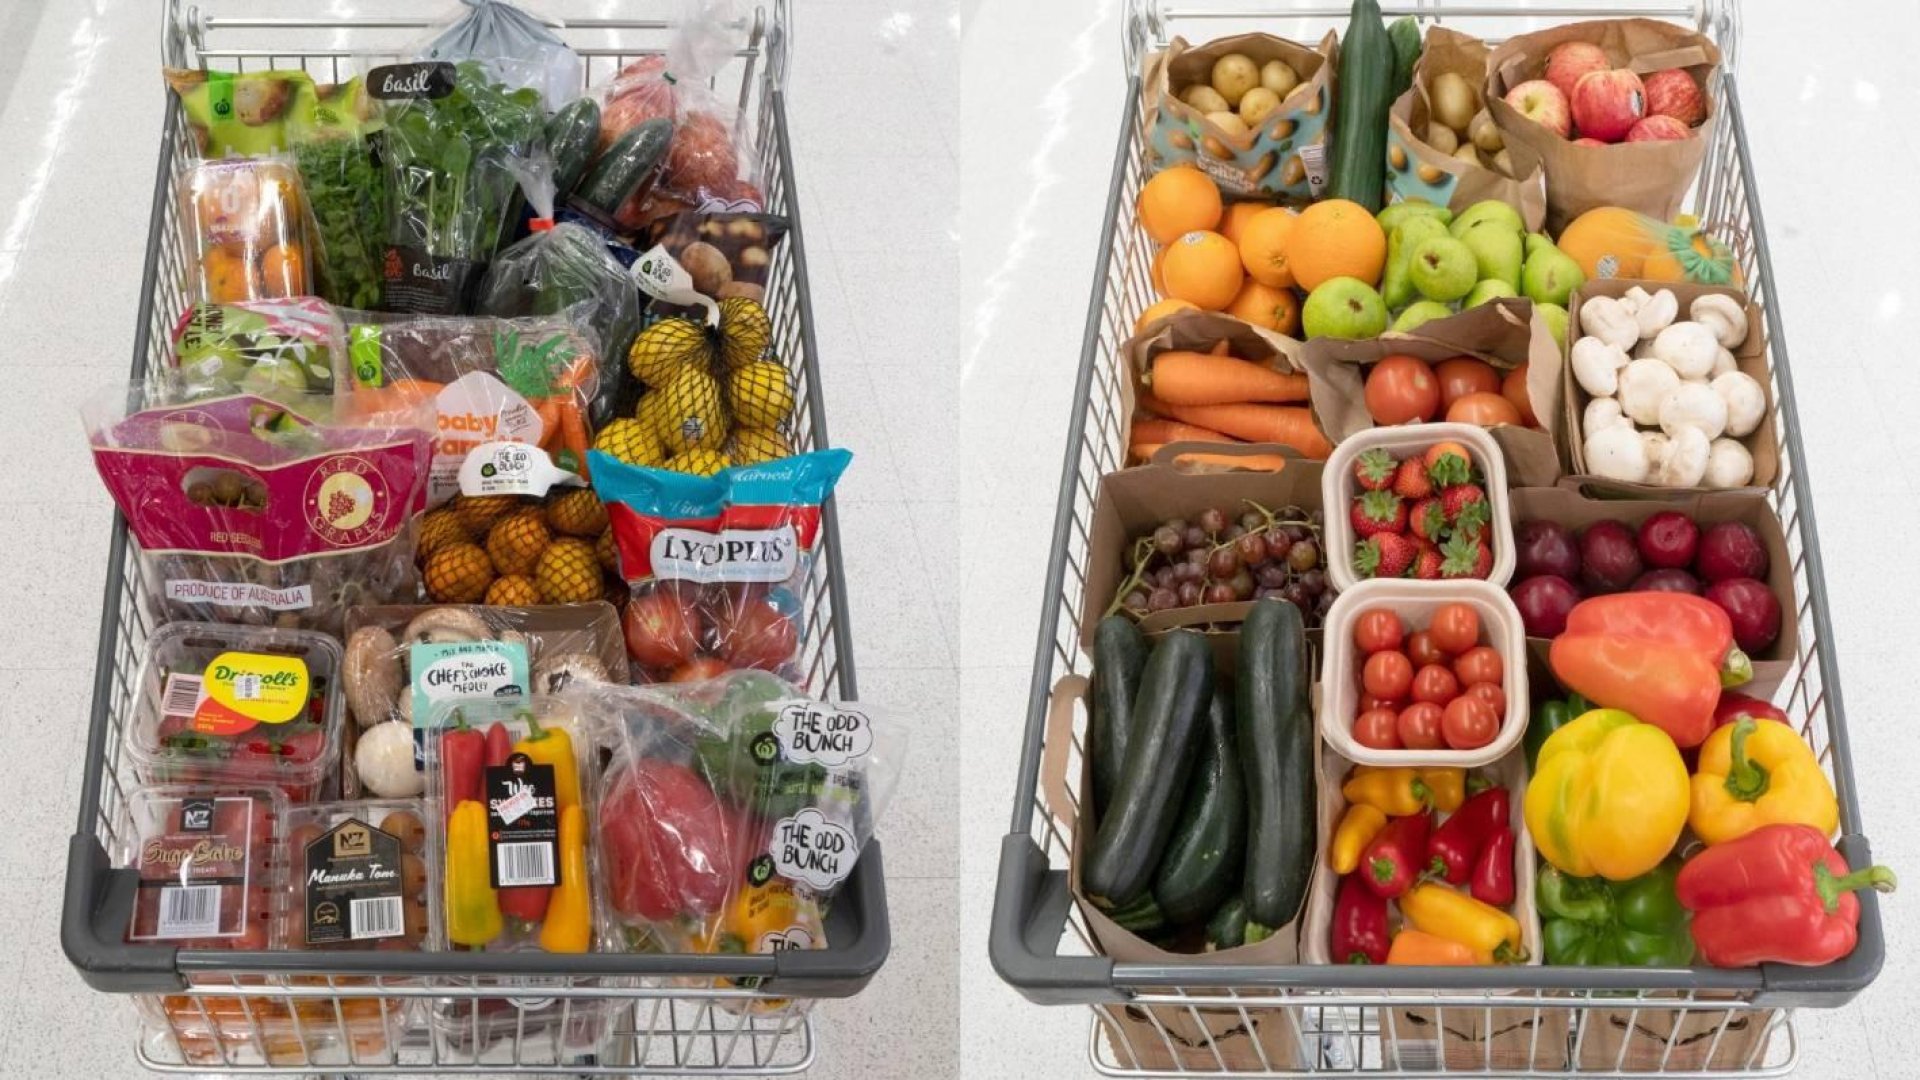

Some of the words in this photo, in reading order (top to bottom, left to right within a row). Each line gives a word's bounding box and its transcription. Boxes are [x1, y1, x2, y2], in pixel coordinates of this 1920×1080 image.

[382, 69, 432, 93] Basil
[412, 263, 450, 280] Basil
[437, 407, 498, 438] baby
[319, 459, 368, 479] RED
[210, 532, 228, 543] RED
[313, 511, 384, 544] GRAPES
[174, 583, 229, 599] PRODUCE
[231, 586, 246, 601] OF
[249, 586, 305, 606] AUSTRALIA
[427, 667, 468, 686] CHEF'S
[469, 662, 507, 679] CHOICE
[791, 711, 822, 734] THE
[826, 714, 860, 732] ODD
[791, 731, 853, 753] BUNCH
[781, 823, 811, 848] THE
[815, 831, 846, 853] ODD
[782, 844, 838, 874] BUNCH
[306, 867, 365, 888] Manuka
